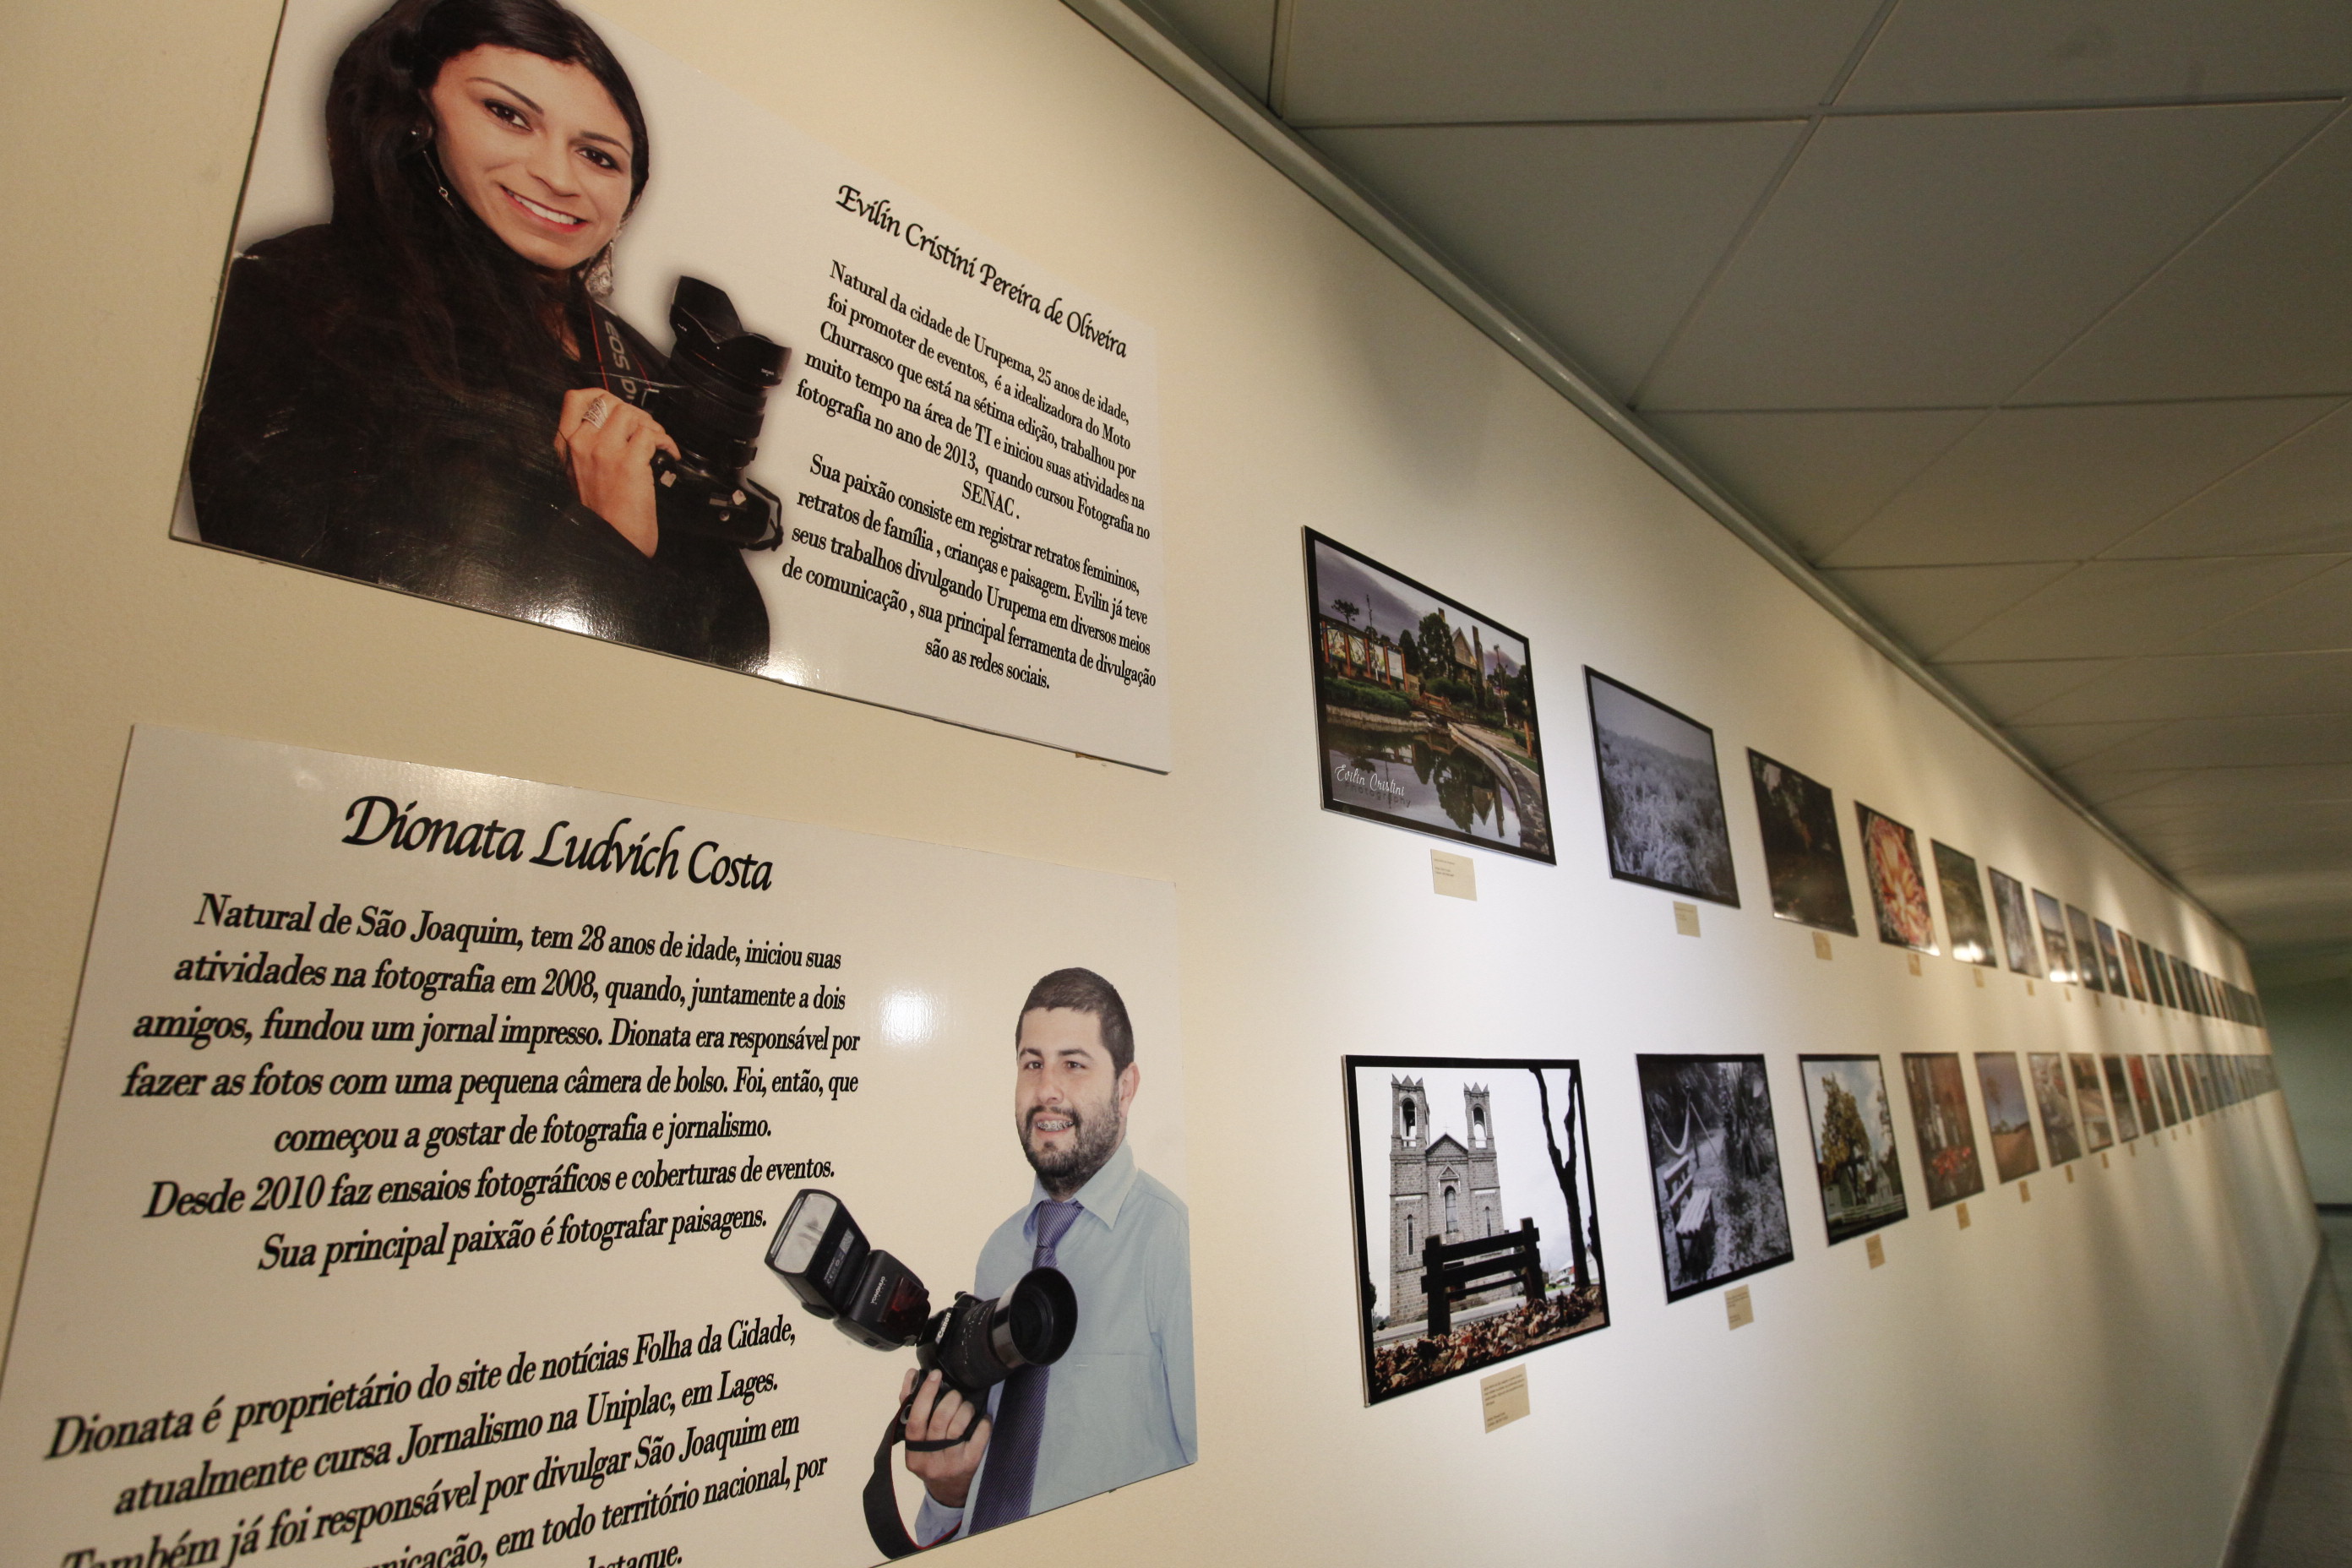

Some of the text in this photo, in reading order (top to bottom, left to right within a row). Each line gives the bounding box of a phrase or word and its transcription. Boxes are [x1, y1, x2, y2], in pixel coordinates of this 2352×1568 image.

[836, 184, 1127, 358] Evilin Cristini Pereira Oliveira
[605, 320, 630, 371] EOS
[826, 292, 1131, 450] foi promoter eventos, idealizadora Moto
[829, 259, 1130, 426] Natural cidade Urupema, 25 anos idade,
[804, 352, 1130, 504] muito tempo área TI iniciou suas atividades
[819, 320, 1136, 480] Churrasco que está sétima edição, trabalhou por
[796, 378, 1135, 535] fotografia ano 2013, quando cursou Fotografia
[797, 492, 860, 525] retratos
[944, 542, 999, 574] crianças
[1009, 568, 1070, 600] paisagem.
[1073, 583, 1109, 613] Evilin
[1109, 597, 1123, 620] já
[1124, 605, 1148, 625] teve
[809, 453, 1140, 596] Sua paixão consiste registrar retratos femininos,
[791, 527, 1151, 656] seus trabalhos divulgando Urupema diversos meios
[917, 604, 943, 623] sua
[944, 611, 1006, 645] principal
[1007, 625, 1077, 665] ferramenta
[1095, 653, 1157, 688] divulgação
[924, 637, 1050, 689] são as redes sociais.
[1335, 764, 1405, 797] Evilin Cristini
[341, 795, 773, 891] Dionata Ludvich Costa
[193, 892, 841, 970] Natural São Joaquim, tem 28 anos idade, iniciou suas
[173, 950, 846, 1012] atividades fotografia 2008, quando, juntamente dois
[133, 1005, 861, 1059] amigos, fundou um jornal impresso. Dionata era responsável por
[121, 1061, 859, 1105] fazer as fotos com uma pequena câmera bolso. Foi, então, que
[274, 1110, 771, 1158] começou gostar fotografia jornalismo.
[142, 1158, 835, 1218] Desde 2010 faz ensaios fotográficos coberturas eventos.
[257, 1205, 767, 1277] Sua principal paixão fotografar paisagens.
[937, 1311, 953, 1339] Canon
[44, 1314, 796, 1460] Dionata proprietário site notícias Folha Cidade,
[113, 1369, 778, 1516] atualmente cursa Jornalismo Uniplac, em Lages.
[220, 1415, 800, 1568] já foi responsável por divulgar São Joaquim em
[495, 1455, 828, 1557] em todo território nacional, por
